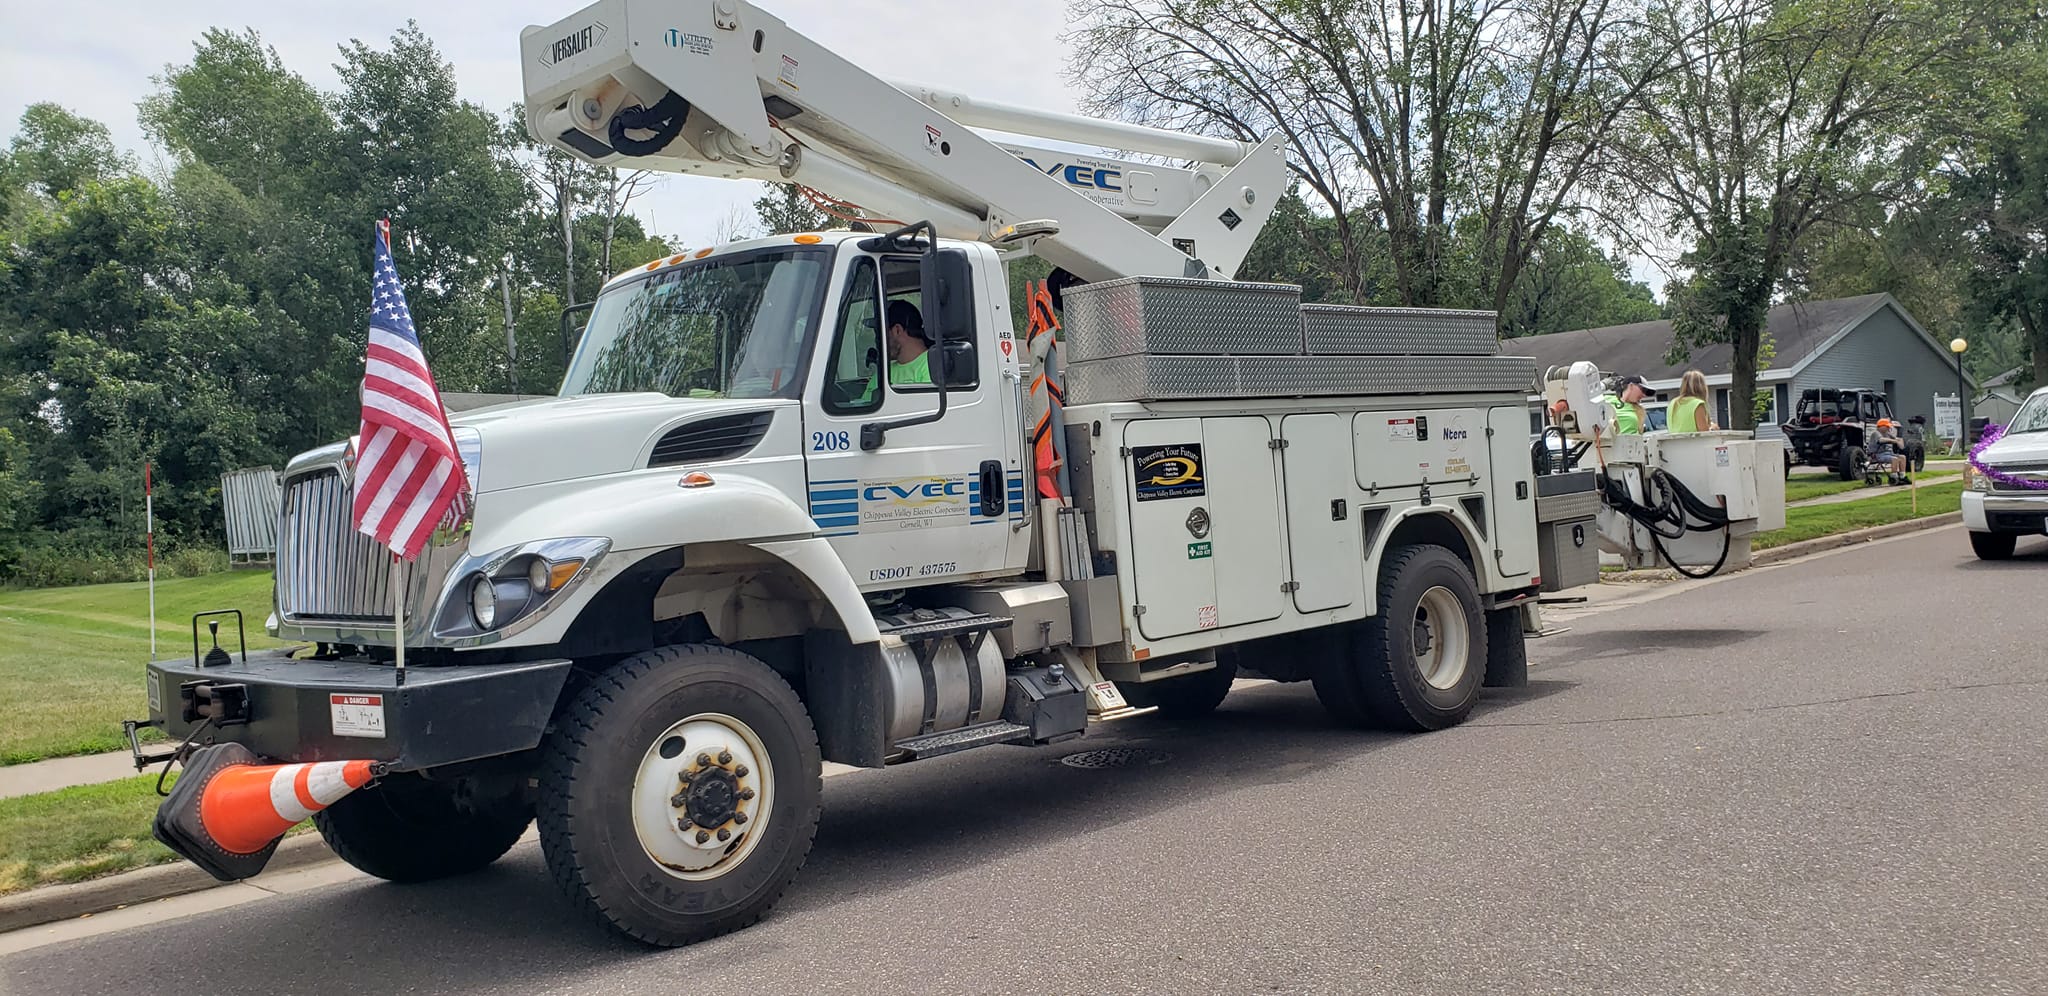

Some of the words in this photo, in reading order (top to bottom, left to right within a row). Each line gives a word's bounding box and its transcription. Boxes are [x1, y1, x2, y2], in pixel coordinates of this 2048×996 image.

[552, 25, 593, 64] VERSALIFT
[684, 33, 712, 44] UTILITY
[999, 331, 1011, 339] AED
[812, 430, 850, 451] 208
[1443, 427, 1467, 440] Ntera
[1137, 450, 1165, 467] Powering
[1165, 447, 1179, 456] Your
[1180, 446, 1199, 462] Future
[863, 482, 965, 501] CVEC
[863, 511, 893, 520] Chippewa
[894, 509, 912, 518] Valley
[913, 507, 933, 516] Electric
[870, 566, 913, 581] USDOT
[919, 562, 956, 576] 437575
